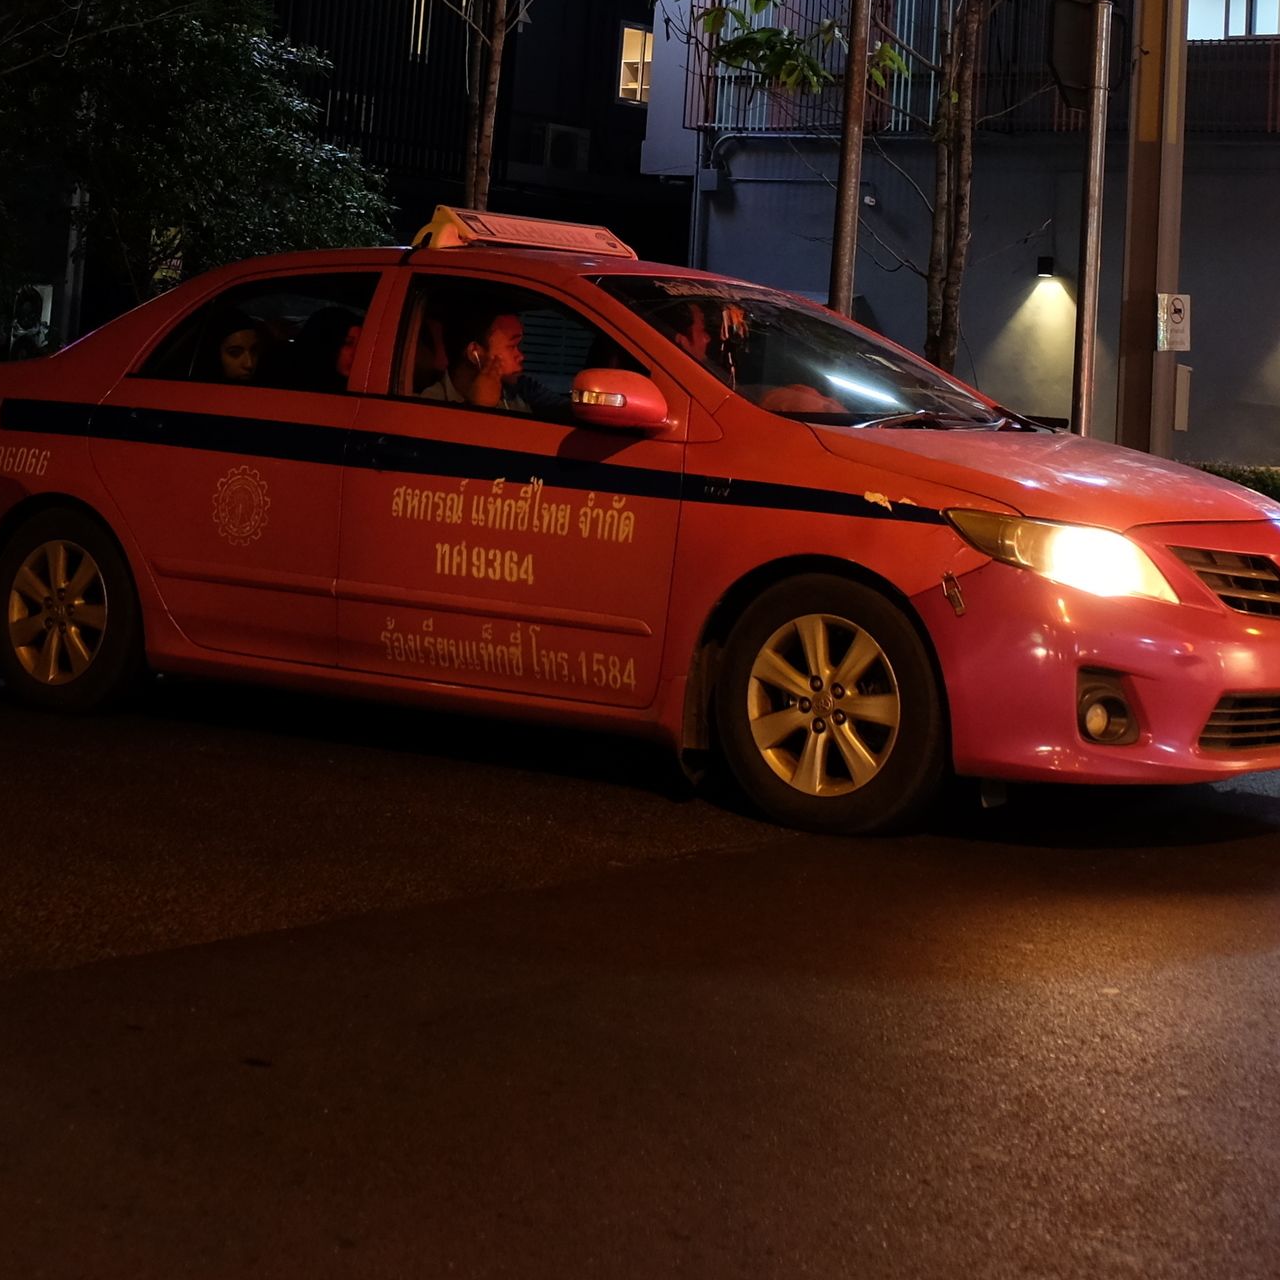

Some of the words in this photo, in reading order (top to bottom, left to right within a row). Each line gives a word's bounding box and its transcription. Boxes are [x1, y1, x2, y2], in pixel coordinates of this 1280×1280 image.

[391, 478, 469, 525] สหกรณ์
[578, 491, 636, 544] จำกัด
